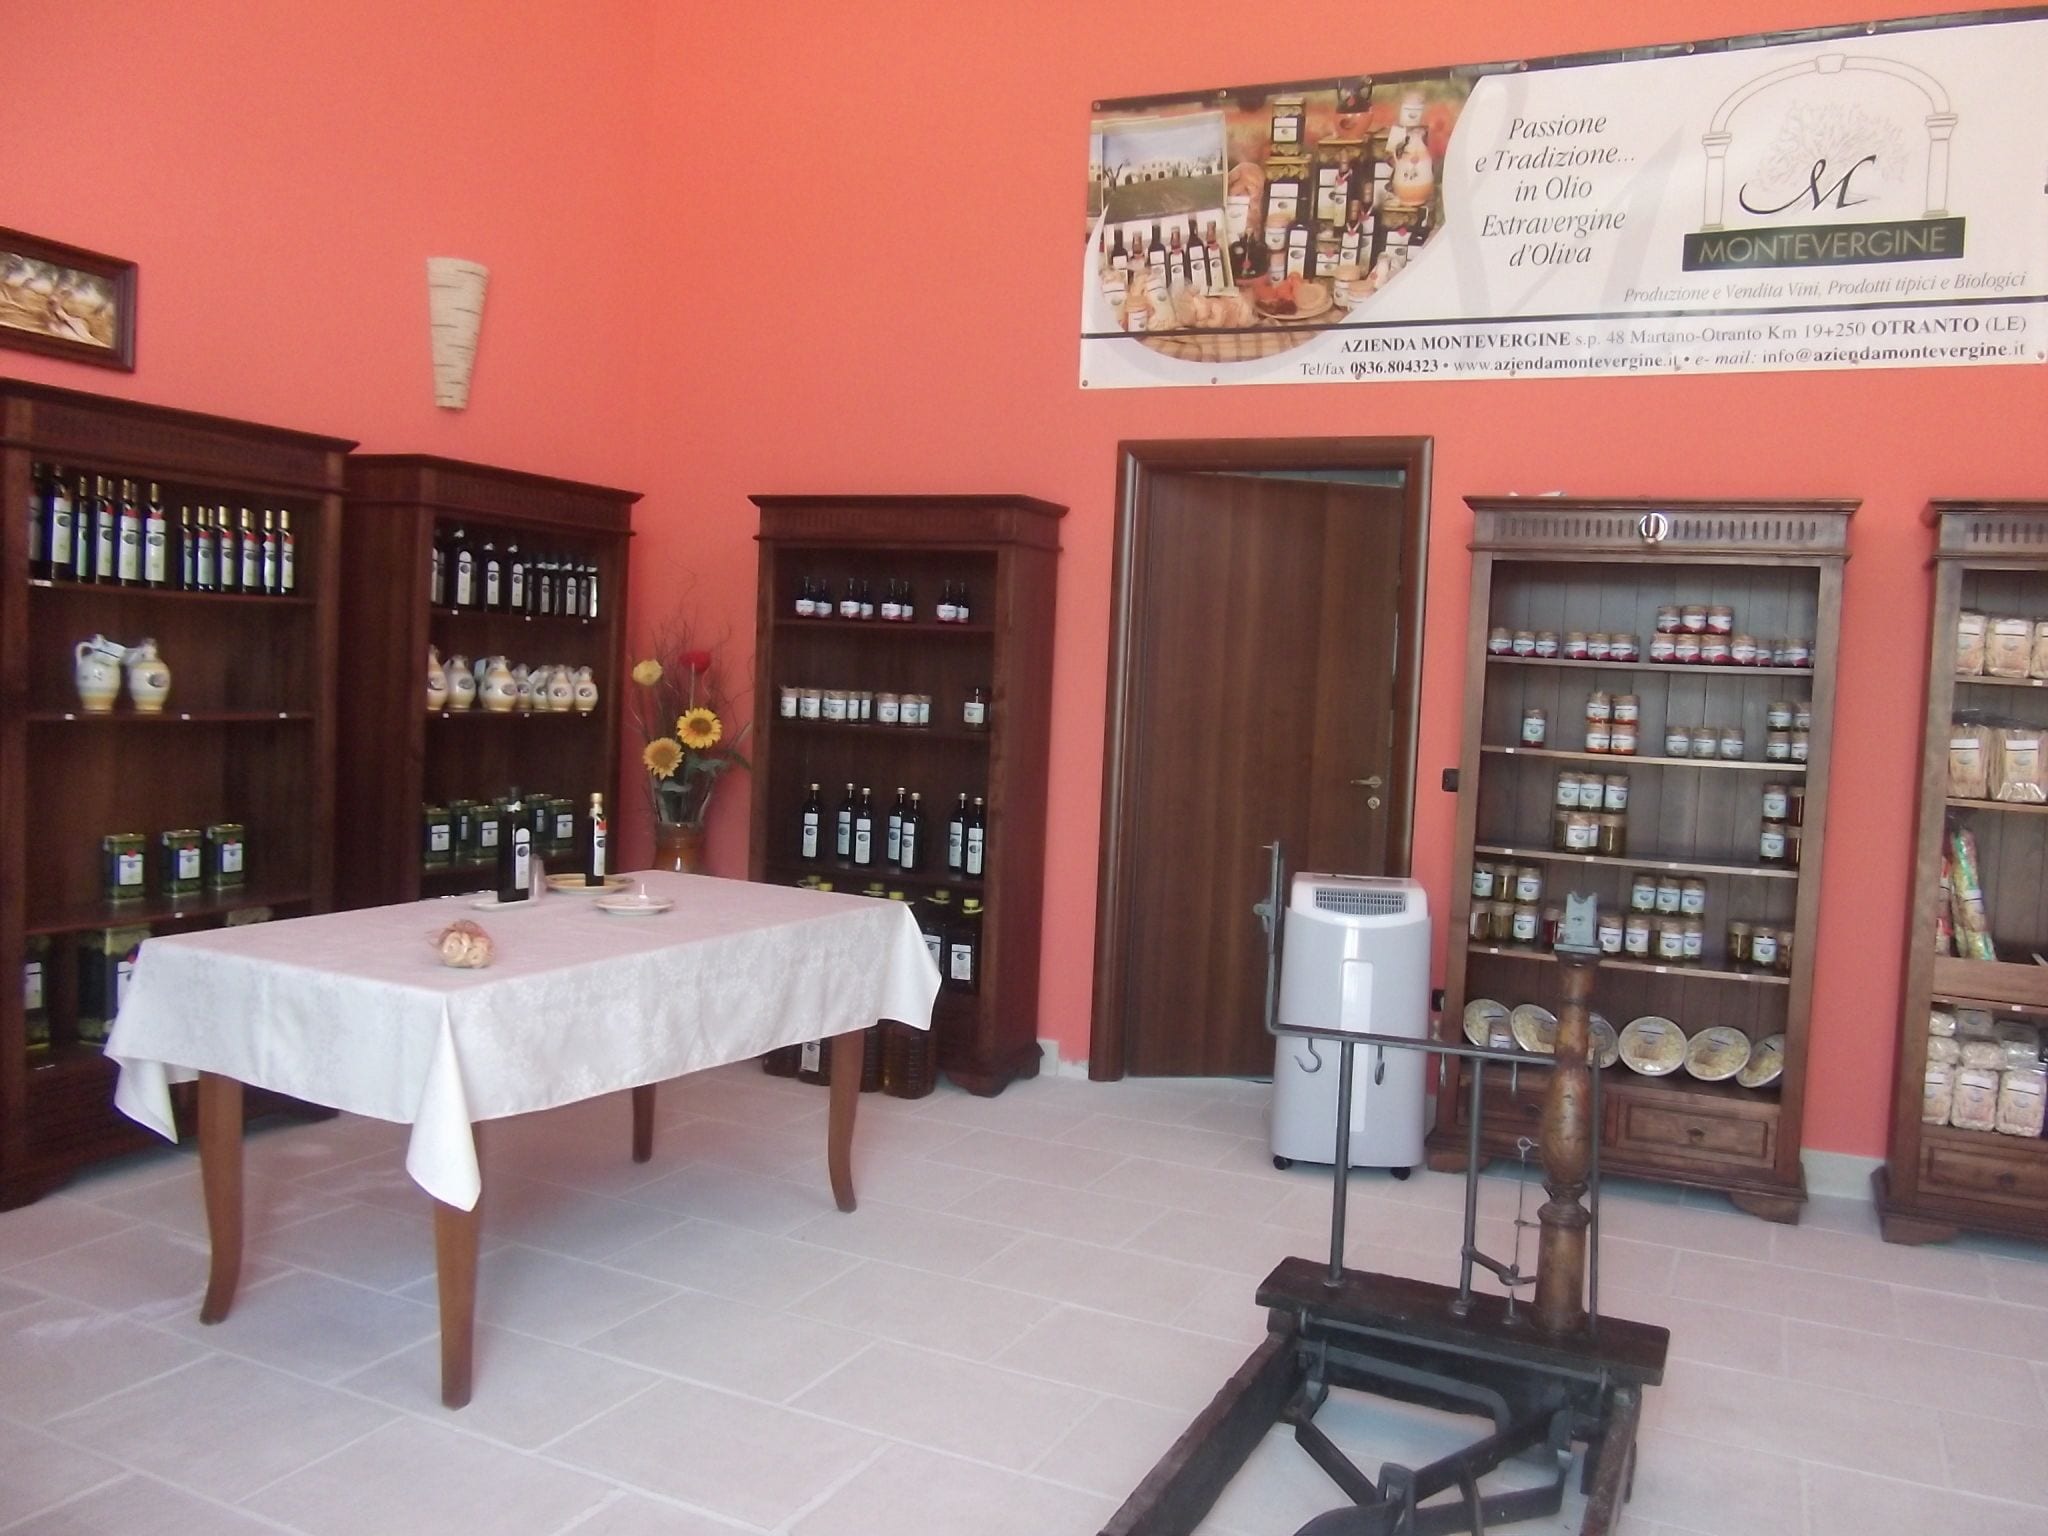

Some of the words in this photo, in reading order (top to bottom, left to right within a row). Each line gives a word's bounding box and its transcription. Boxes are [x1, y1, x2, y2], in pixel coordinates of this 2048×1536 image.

[1508, 114, 1607, 140] Passione
[1475, 156, 1487, 173] e
[1495, 145, 1635, 171] Tradizione...
[1515, 180, 1538, 202] in
[1545, 175, 1593, 201] Olio
[1481, 208, 1626, 239] Extravergine
[1699, 226, 1947, 264] MONTEVERGINE
[1624, 285, 1710, 303] Produzione
[1713, 287, 1721, 300] e
[1726, 281, 1783, 299] Vendita
[1787, 279, 1822, 298] Vini,
[1827, 277, 1891, 296] Prodotti
[1895, 275, 1937, 296] tipici
[1940, 277, 1950, 290] e
[1954, 271, 2027, 291] Biologici
[1340, 337, 1416, 353] AZIENDA
[1421, 331, 1571, 350] MONTEVERGINE
[1575, 334, 1600, 348] s.p.
[1606, 331, 1625, 345] 48
[1630, 327, 1762, 344] Martano-Otranto
[1768, 325, 1796, 340] Km
[1804, 321, 1866, 339] 19+250
[1871, 317, 1980, 335] OTRANTO
[1985, 316, 2027, 333] (LE)
[1300, 361, 1345, 376] Tel/fax
[1350, 359, 1439, 375] 0836.804323
[1453, 354, 1677, 372] www.aziendamontevergine.it
[1763, 340, 2025, 364] info@aziendamontevergine.it
